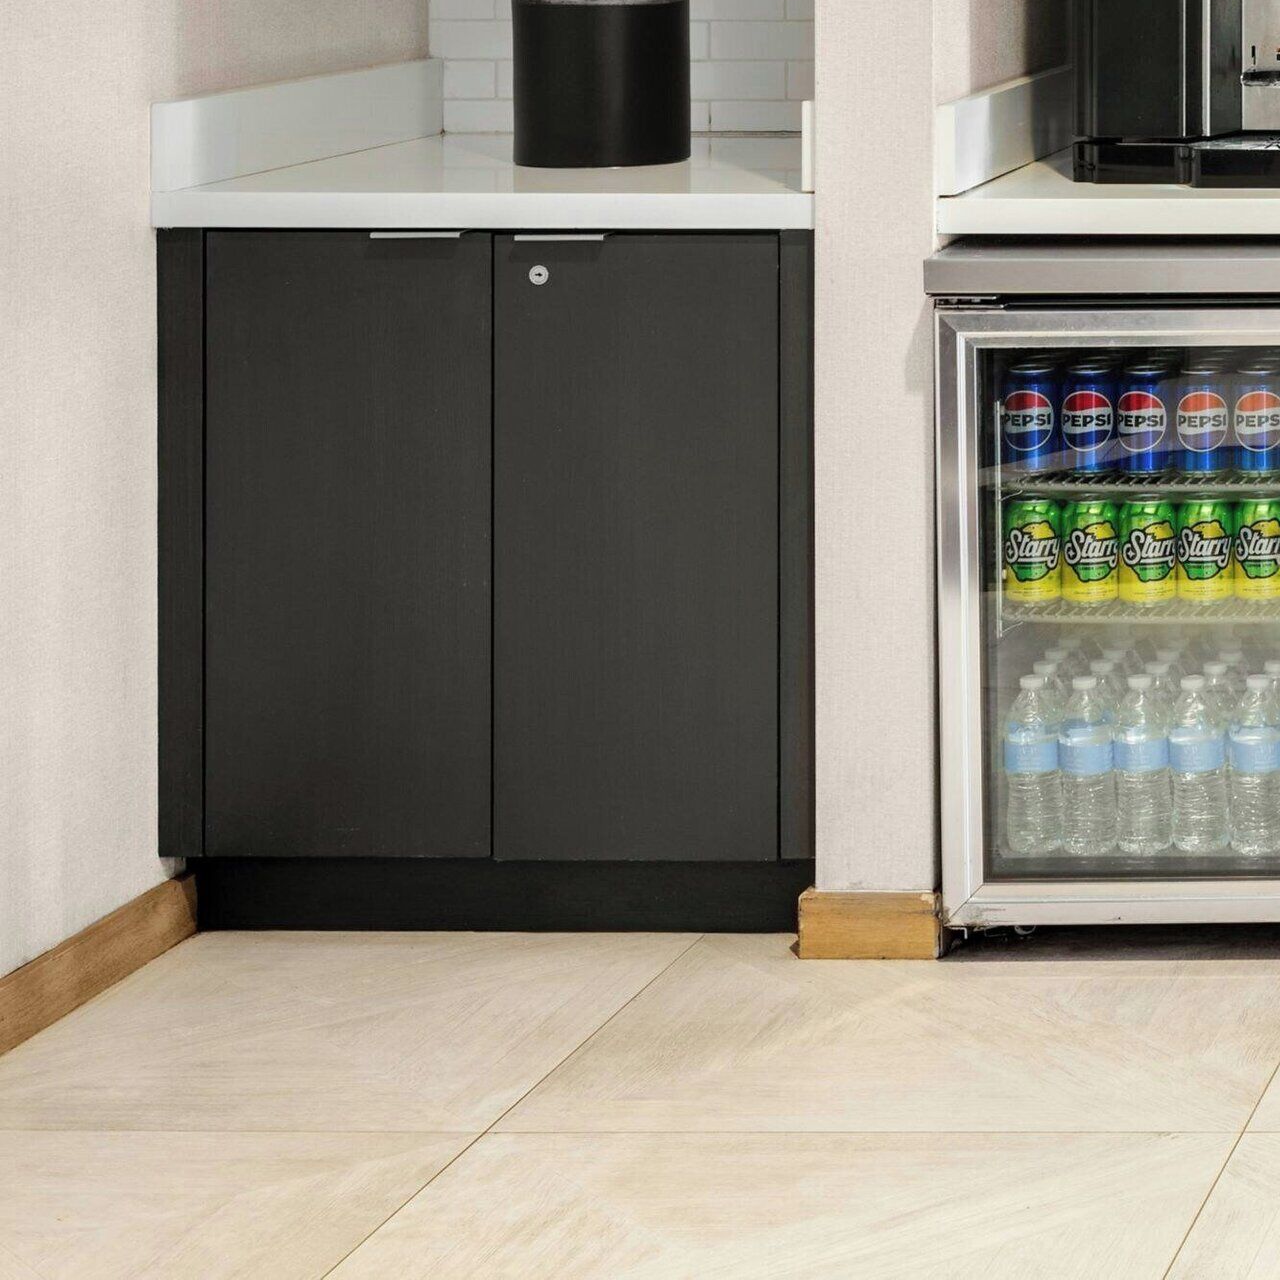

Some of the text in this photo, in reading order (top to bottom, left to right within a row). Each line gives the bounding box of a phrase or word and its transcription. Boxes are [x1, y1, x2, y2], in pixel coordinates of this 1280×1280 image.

[1062, 413, 1111, 427] PEPSI
[1118, 414, 1164, 427] PEPSI
[1178, 414, 1226, 427] PEPSI
[1005, 529, 1060, 569] Starry
[1177, 528, 1232, 568] Starry
